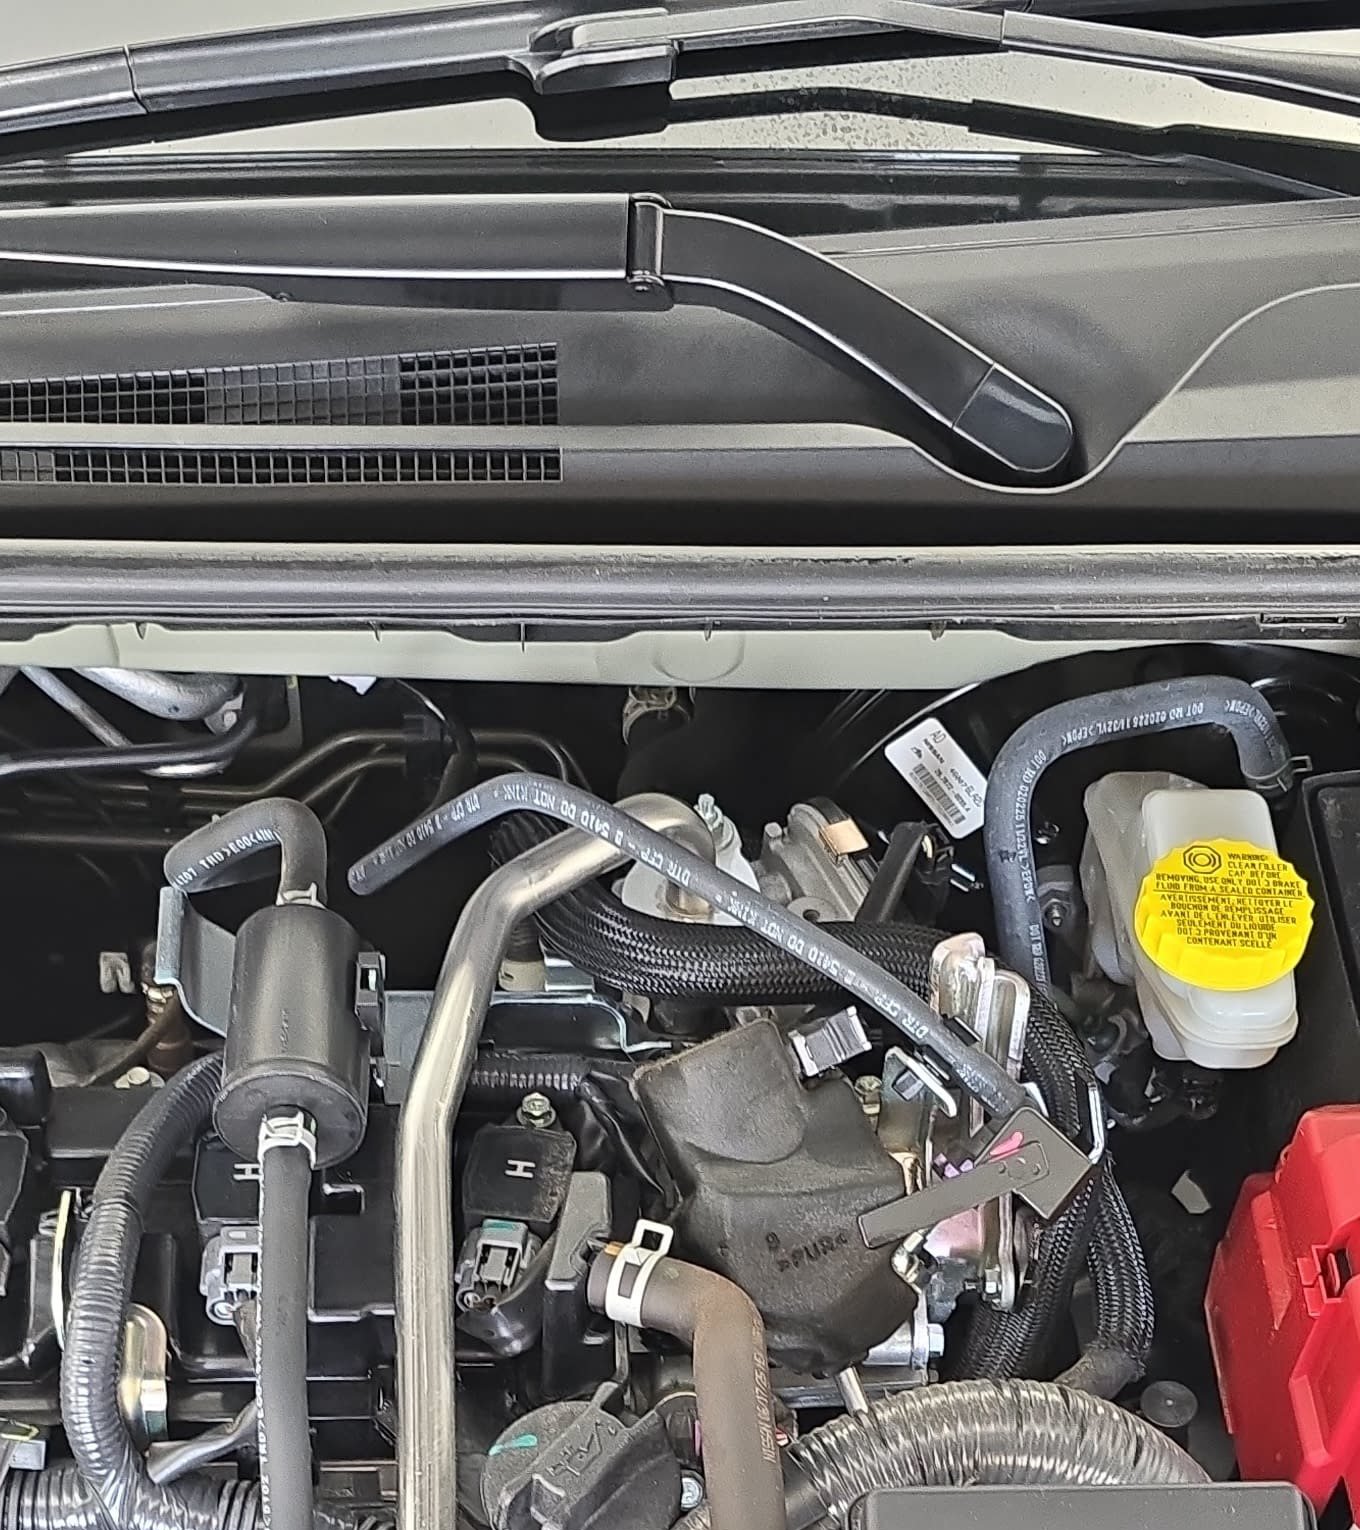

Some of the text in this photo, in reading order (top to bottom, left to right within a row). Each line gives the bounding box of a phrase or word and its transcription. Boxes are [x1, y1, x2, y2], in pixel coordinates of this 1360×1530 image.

[531, 790, 556, 809] NOT
[1258, 863, 1288, 871] FILLER
[1250, 871, 1281, 879] BEFORE
[1156, 882, 1182, 890] FLUID
[1183, 883, 1208, 891] FROM
[1220, 885, 1253, 894] SEALED
[1203, 876, 1218, 884] USE
[1221, 877, 1243, 885] ONLY
[1246, 879, 1261, 887] DOT
[1272, 880, 1300, 888] BRAKE
[1171, 902, 1284, 915] BOUCHON DE REMPLISSAGE
[1235, 897, 1281, 907] NETTOYER
[1283, 900, 1292, 908] LE
[1160, 910, 1190, 918] AVANT
[1193, 911, 1205, 919] DE
[1259, 915, 1296, 924] UTILISER
[1177, 918, 1276, 931] SEULEMENT DU LIQUIDE
[1177, 927, 1192, 935] DOT
[1196, 928, 1201, 936] 3
[1203, 929, 1254, 939] PROVENANT
[1187, 937, 1238, 947] CONTENANT
[505, 1159, 537, 1179] H
